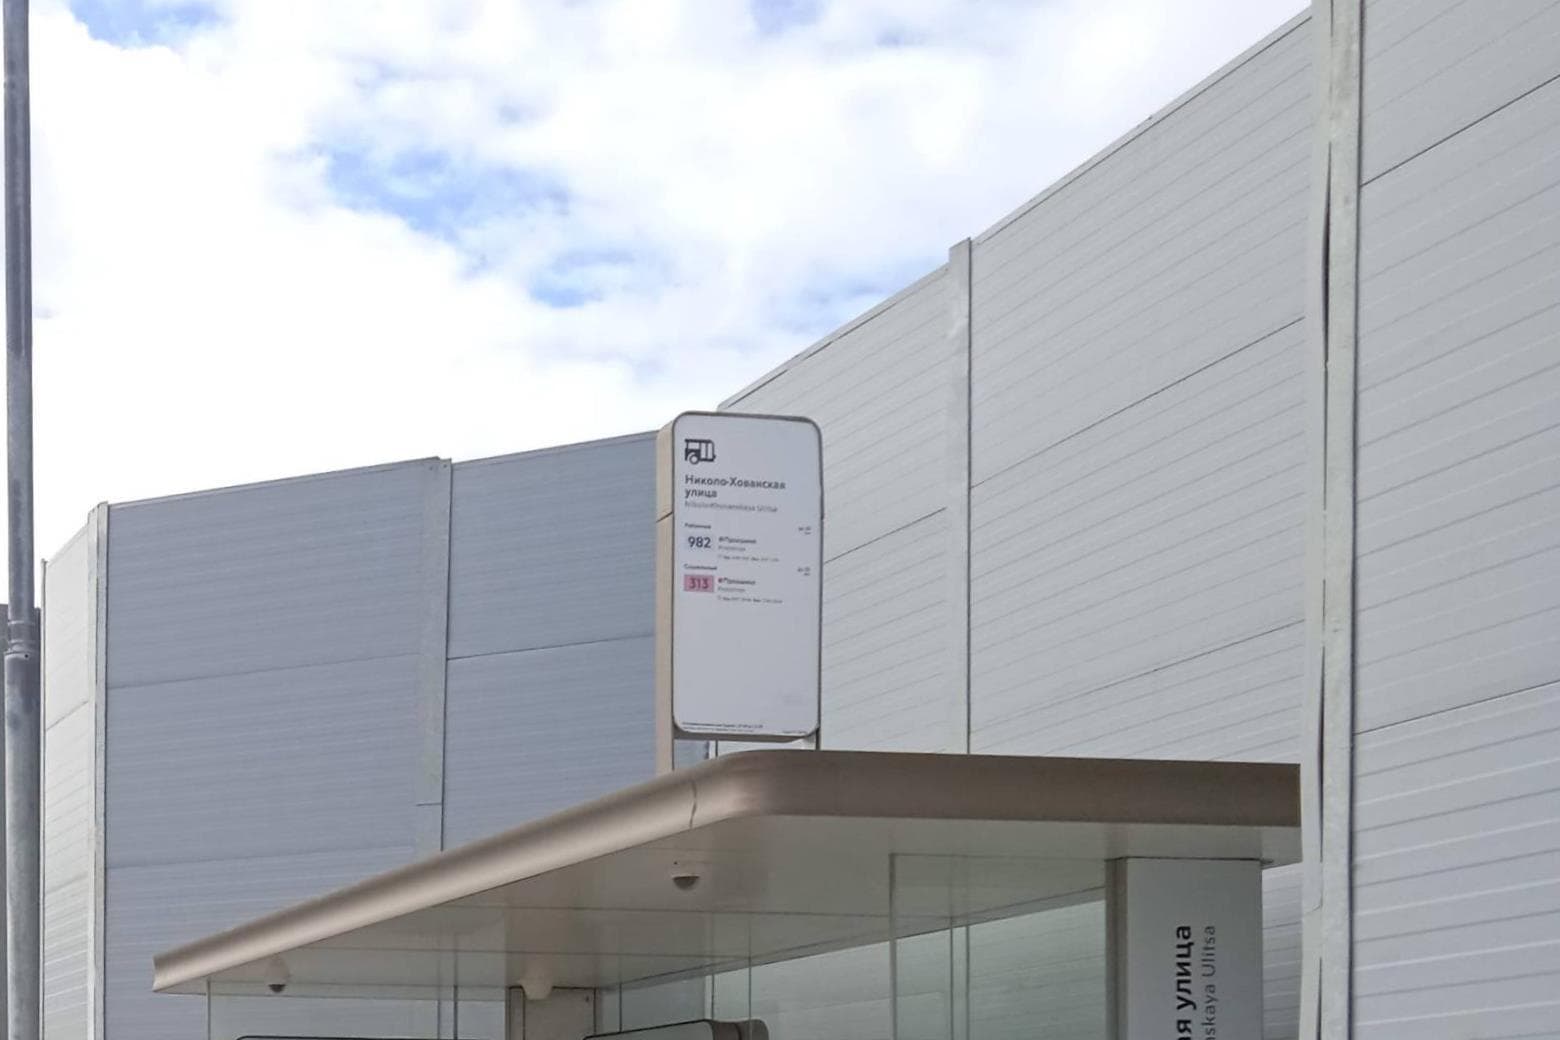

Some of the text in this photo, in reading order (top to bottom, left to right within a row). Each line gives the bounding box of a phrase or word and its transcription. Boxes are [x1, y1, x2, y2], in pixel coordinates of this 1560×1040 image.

[684, 474, 786, 490] Николо-Хованская
[684, 488, 718, 499] улица
[687, 536, 712, 549] 982
[688, 577, 710, 590] 313
[1201, 925, 1216, 977] Ulitsa
[1175, 925, 1197, 1012] улица
